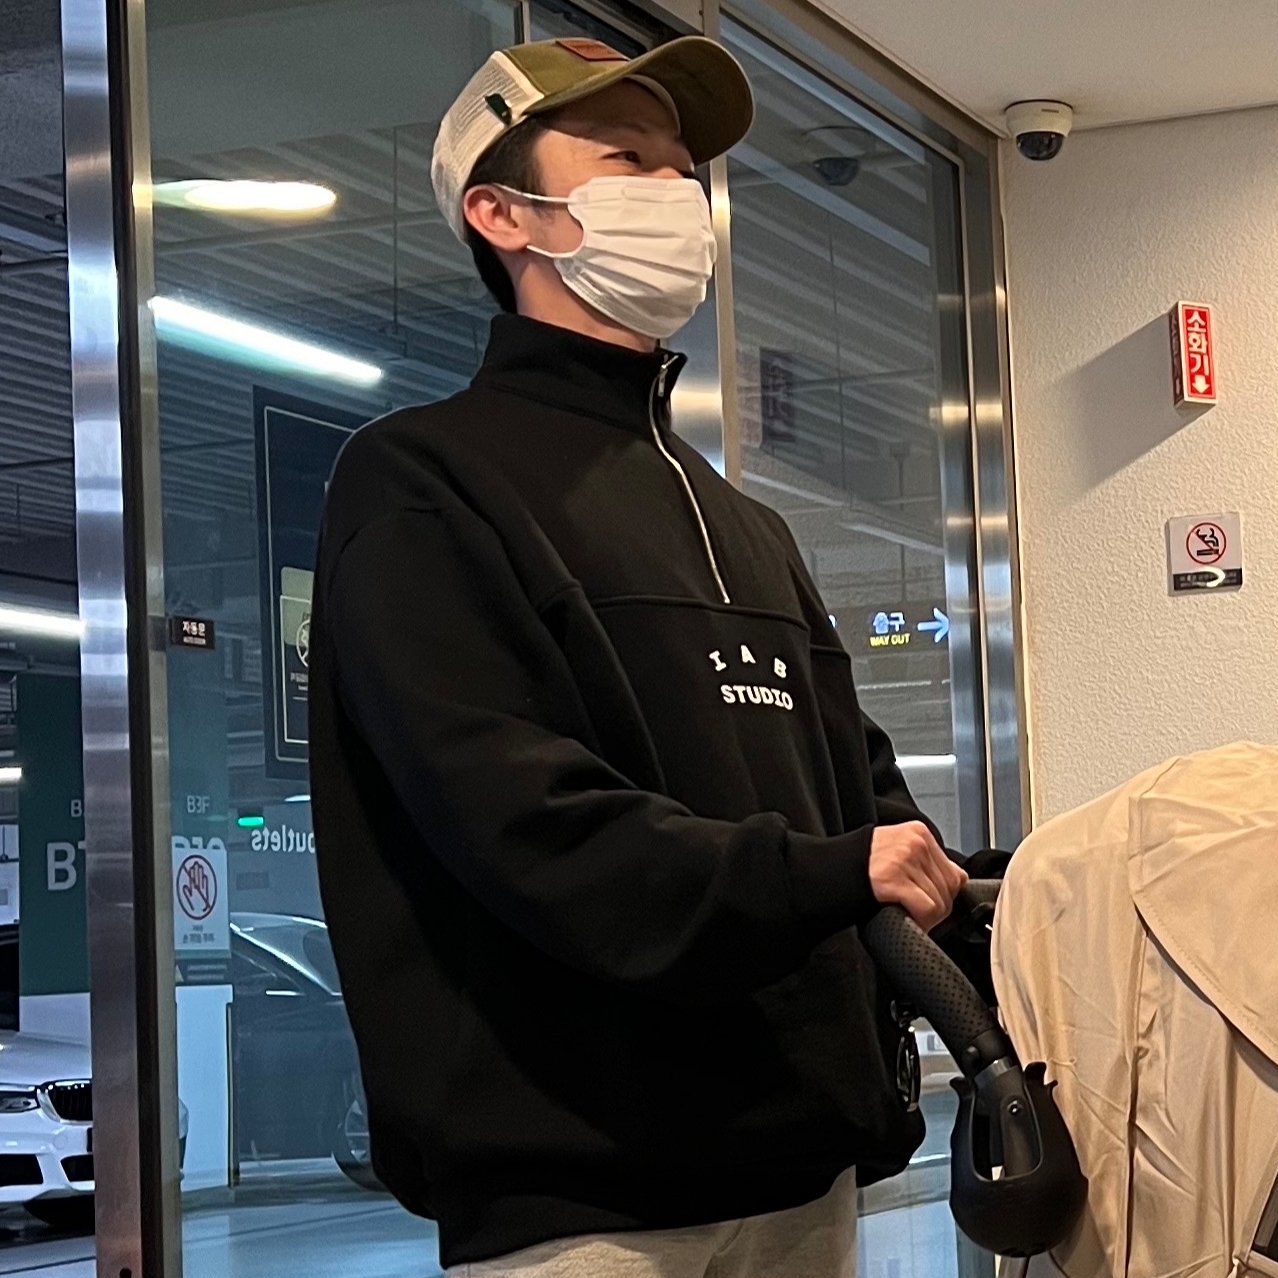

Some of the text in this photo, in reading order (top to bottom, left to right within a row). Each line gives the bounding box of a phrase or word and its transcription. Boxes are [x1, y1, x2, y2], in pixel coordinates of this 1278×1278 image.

[1187, 310, 1210, 376] 소화기
[870, 633, 910, 647] WAY OUT
[720, 684, 793, 711] STUDIO
[186, 795, 210, 813] B3F
